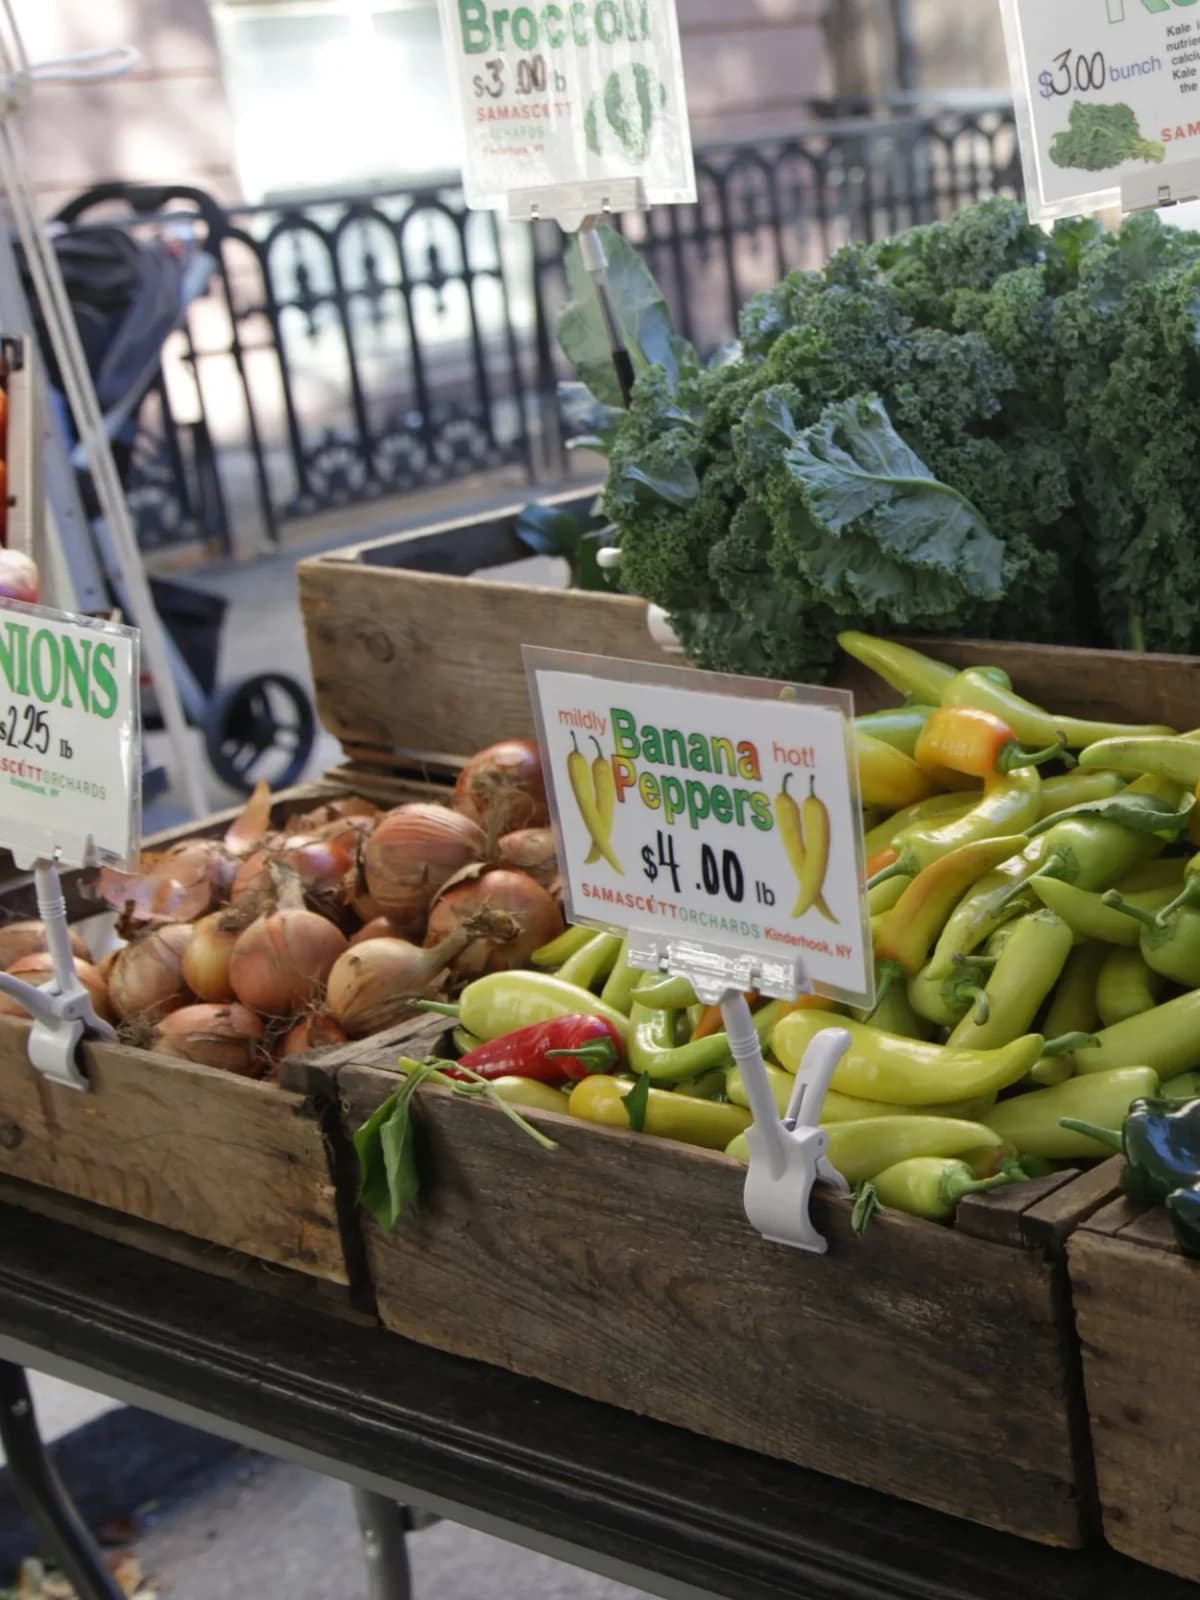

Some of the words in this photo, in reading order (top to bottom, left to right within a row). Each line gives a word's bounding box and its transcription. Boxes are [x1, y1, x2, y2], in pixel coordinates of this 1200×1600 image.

[1166, 24, 1191, 37] Kale
[1038, 48, 1105, 100] $3.00
[1109, 56, 1161, 82] bunch
[1172, 67, 1197, 80] Kale
[1180, 82, 1197, 94] the
[558, 709, 608, 736] mildly
[60, 738, 74, 759] lb
[610, 707, 762, 781] Banana
[773, 741, 816, 768] hot!
[611, 754, 774, 831] Peppers
[755, 880, 775, 906] lb
[836, 945, 853, 959] NY
